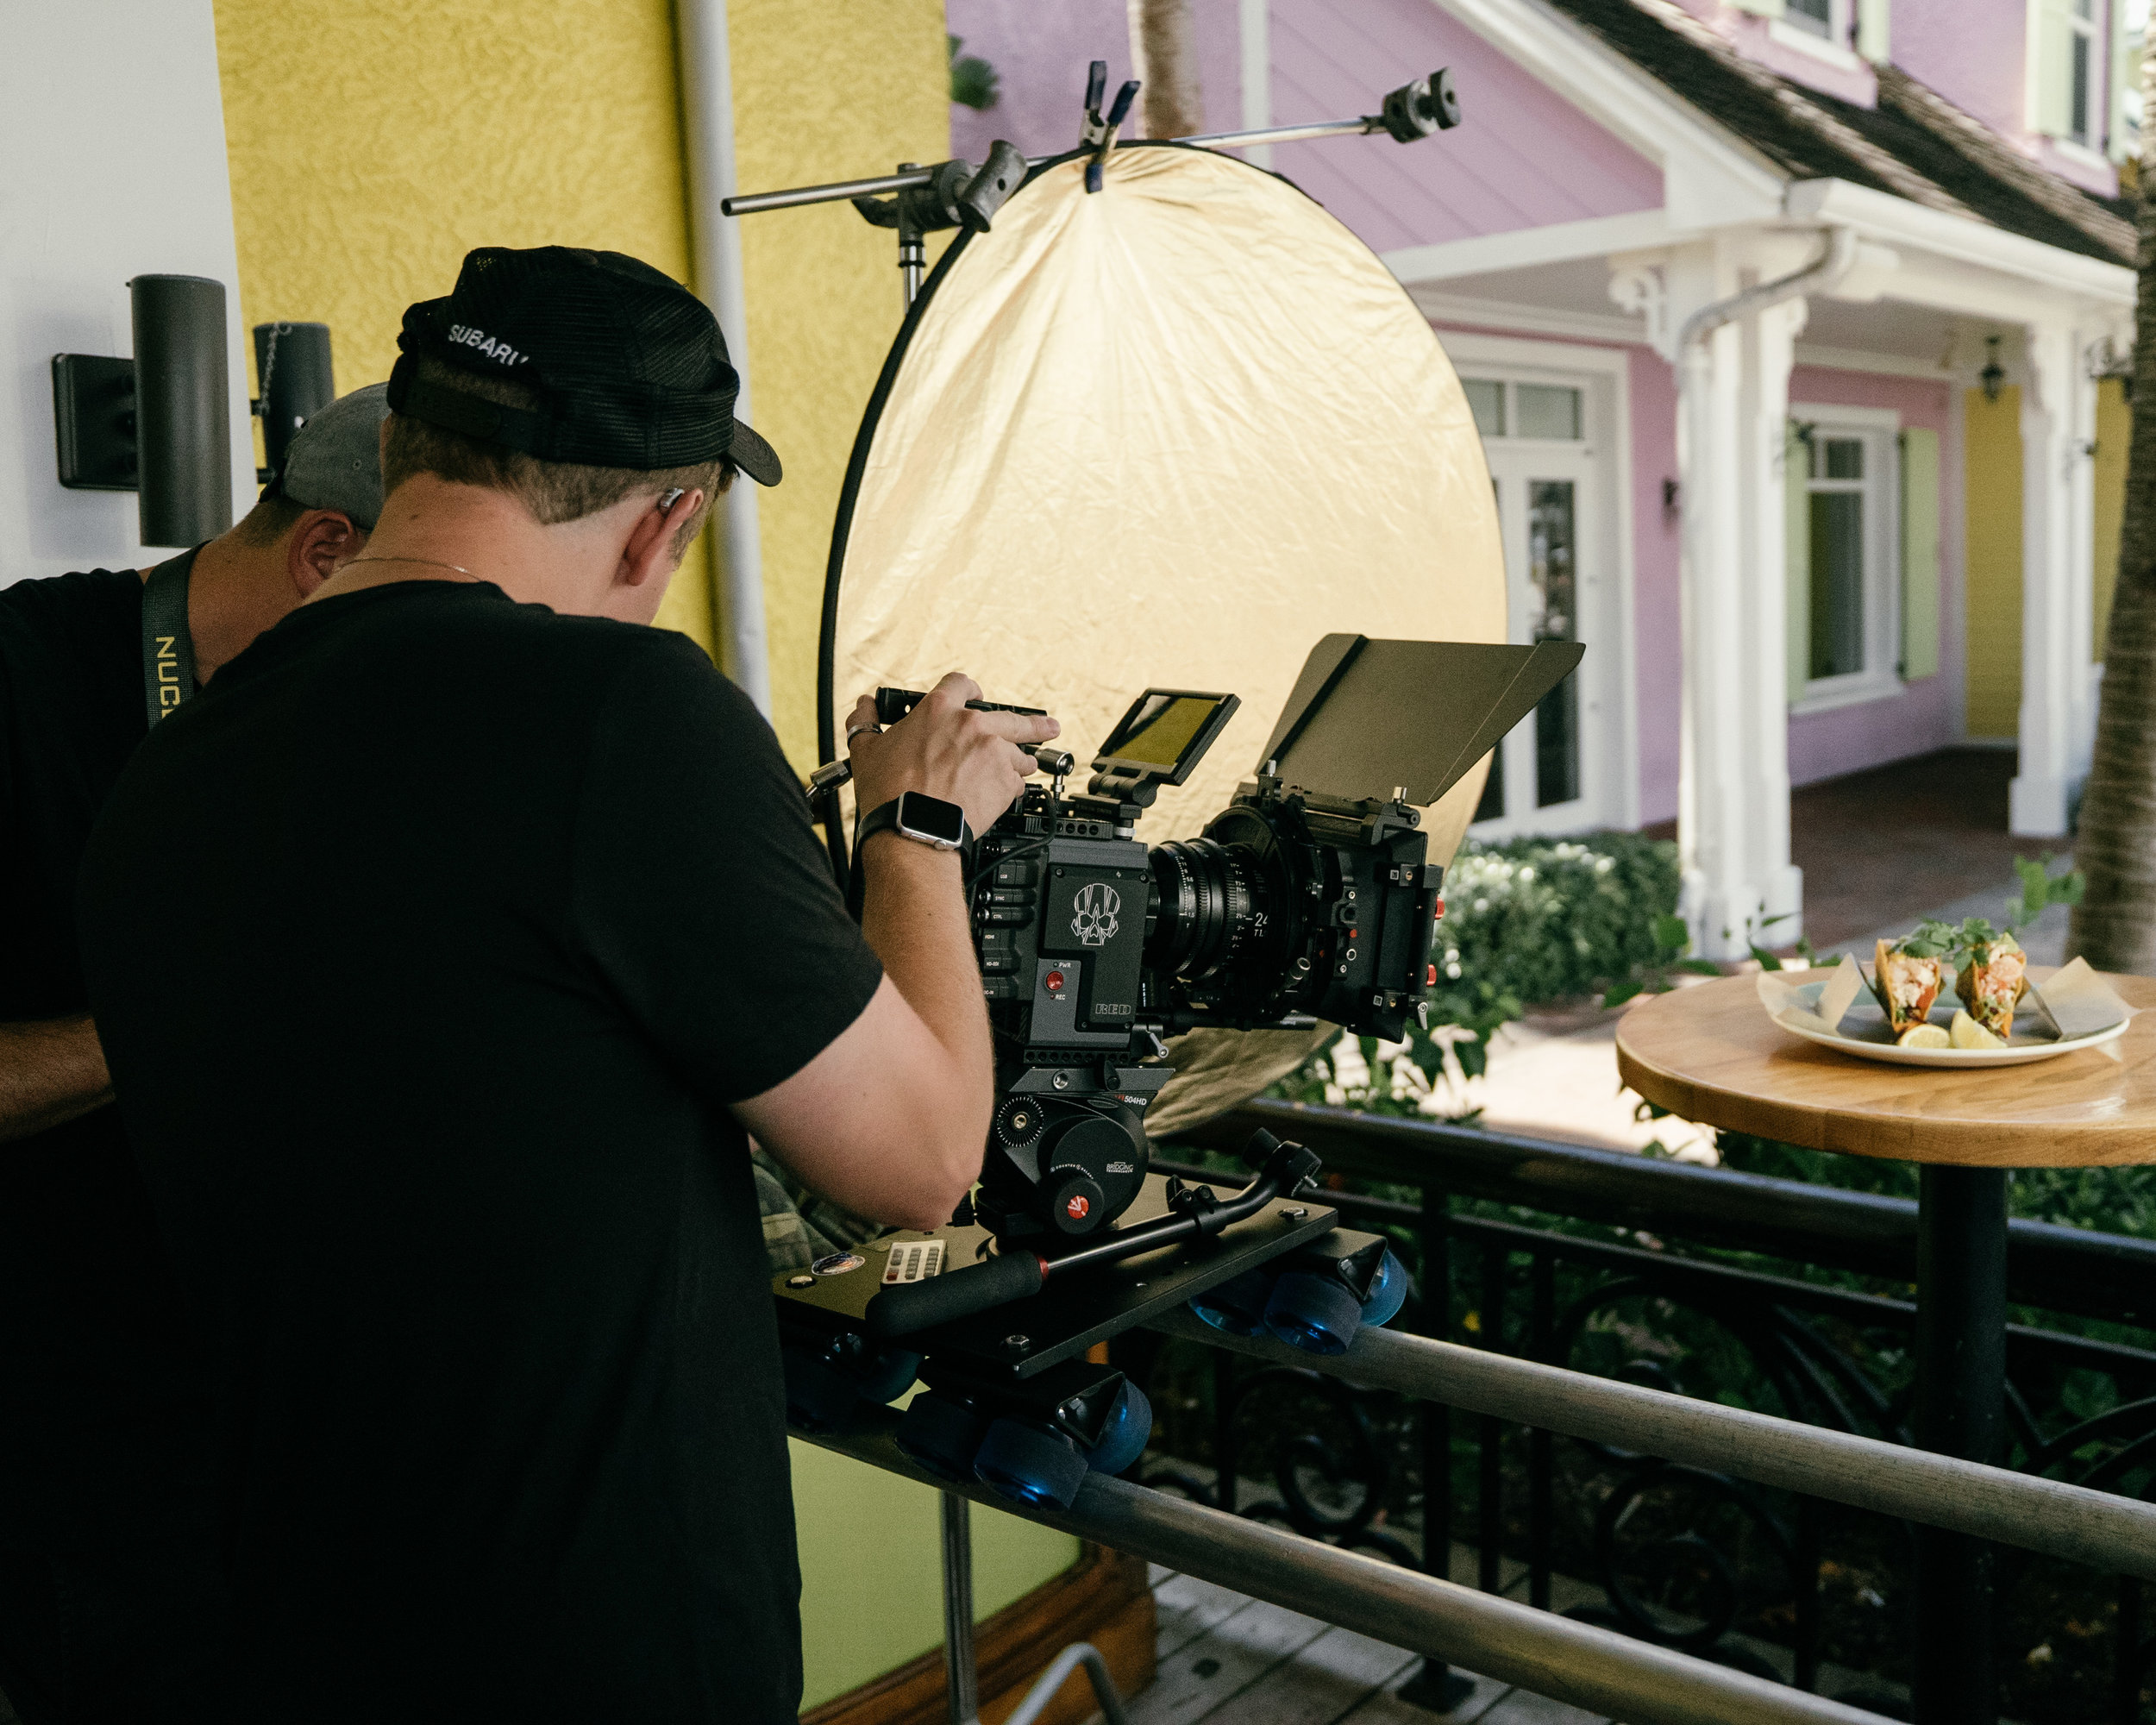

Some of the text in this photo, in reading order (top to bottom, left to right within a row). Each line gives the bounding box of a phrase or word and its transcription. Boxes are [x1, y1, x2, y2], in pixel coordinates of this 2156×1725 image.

[1094, 1003, 1131, 1015] RED
[1124, 1095, 1147, 1106] 504HD
[1106, 1162, 1134, 1170] BRIDGING
